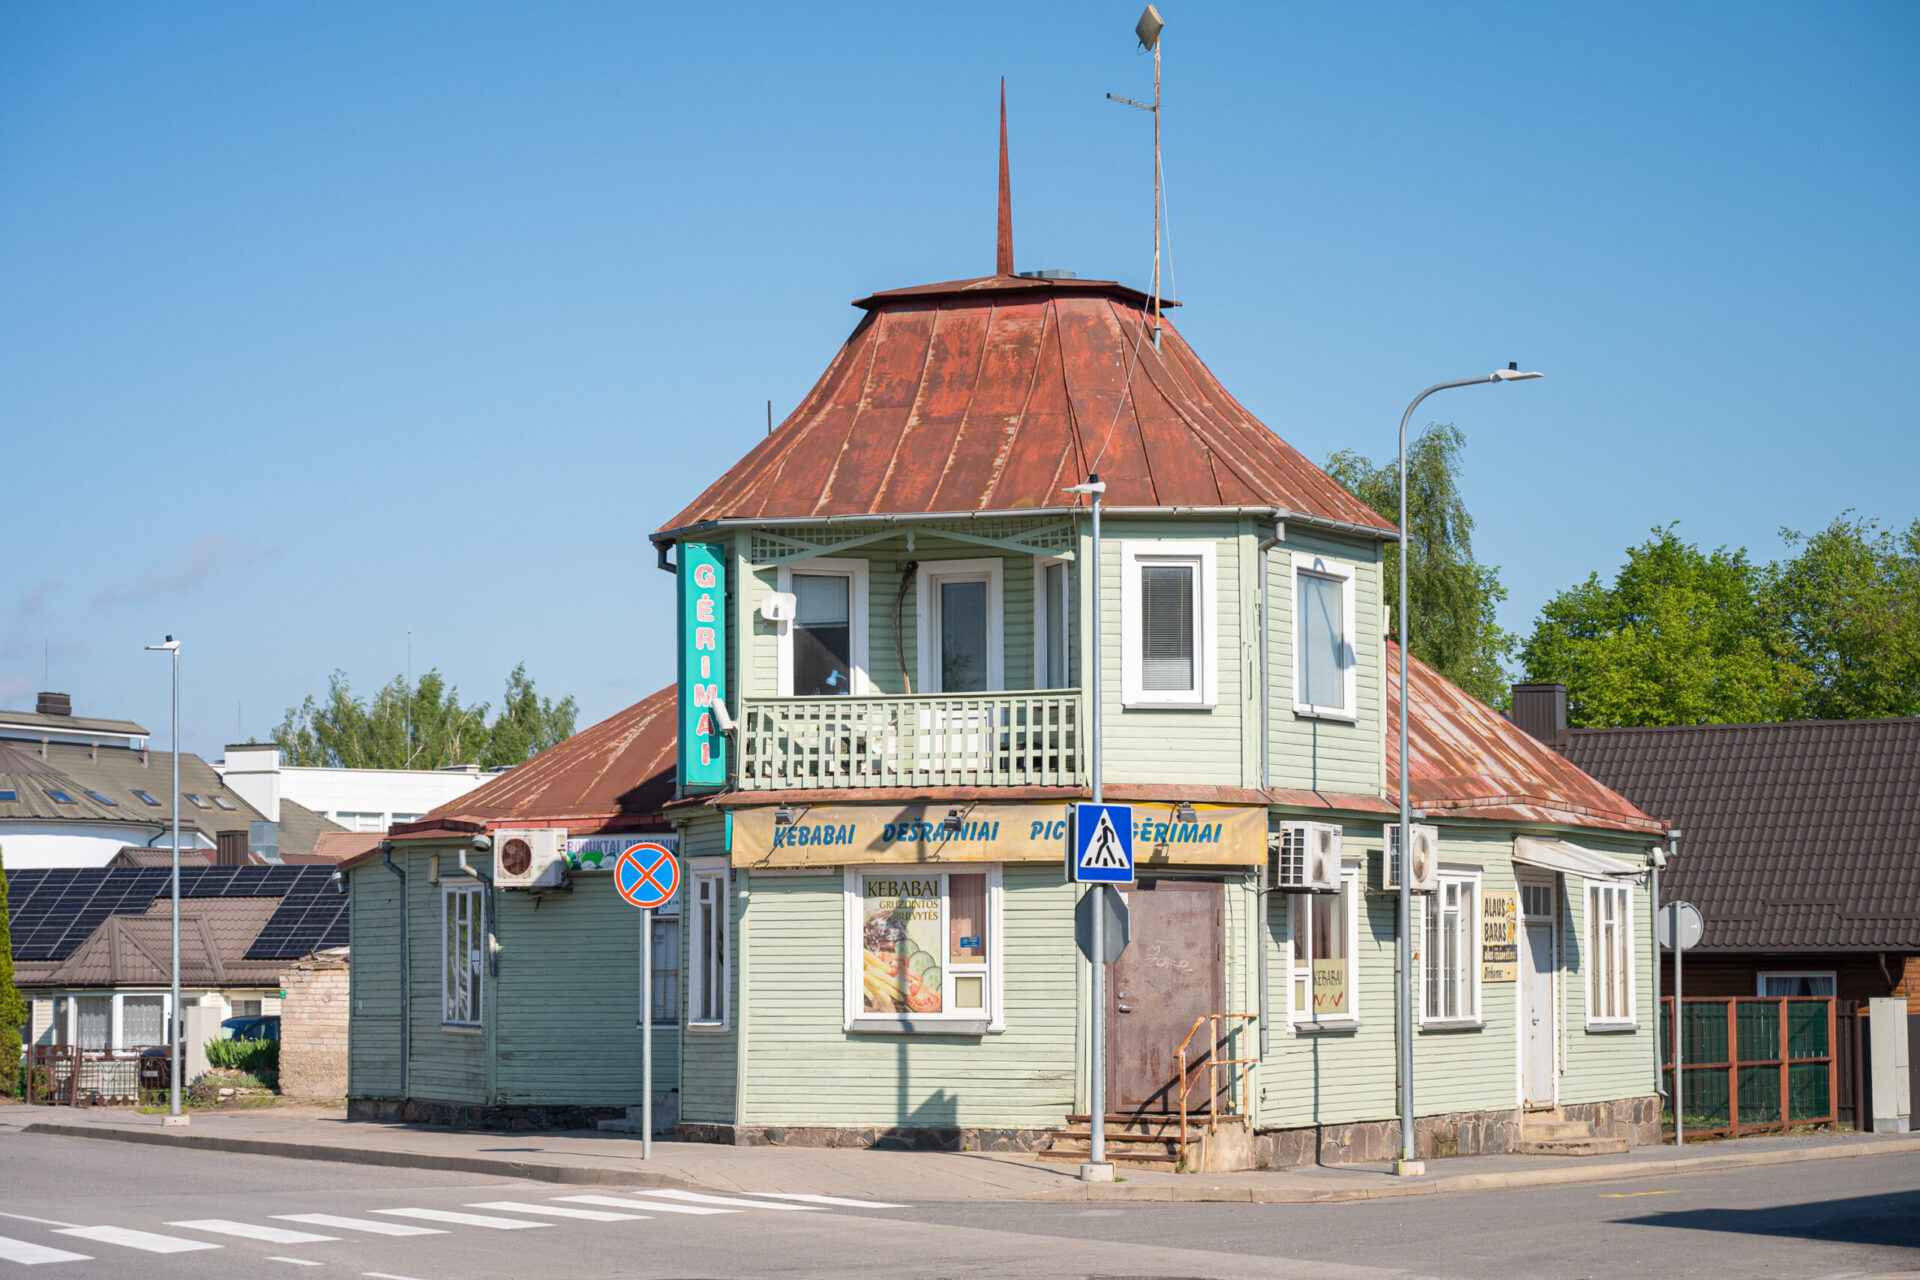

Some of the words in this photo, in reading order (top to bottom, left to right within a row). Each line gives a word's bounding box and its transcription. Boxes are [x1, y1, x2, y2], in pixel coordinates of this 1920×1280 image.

[694, 564, 718, 766] GĖRIMAI
[773, 824, 856, 848] KEBABAI
[567, 840, 620, 853] RODUKTAI
[867, 880, 939, 897] KEBABAI
[879, 900, 939, 909] GRUZDINTOS
[1484, 897, 1506, 918] ALAUS
[896, 911, 939, 921] BULVYTĖS
[1484, 922, 1507, 942] BARAS
